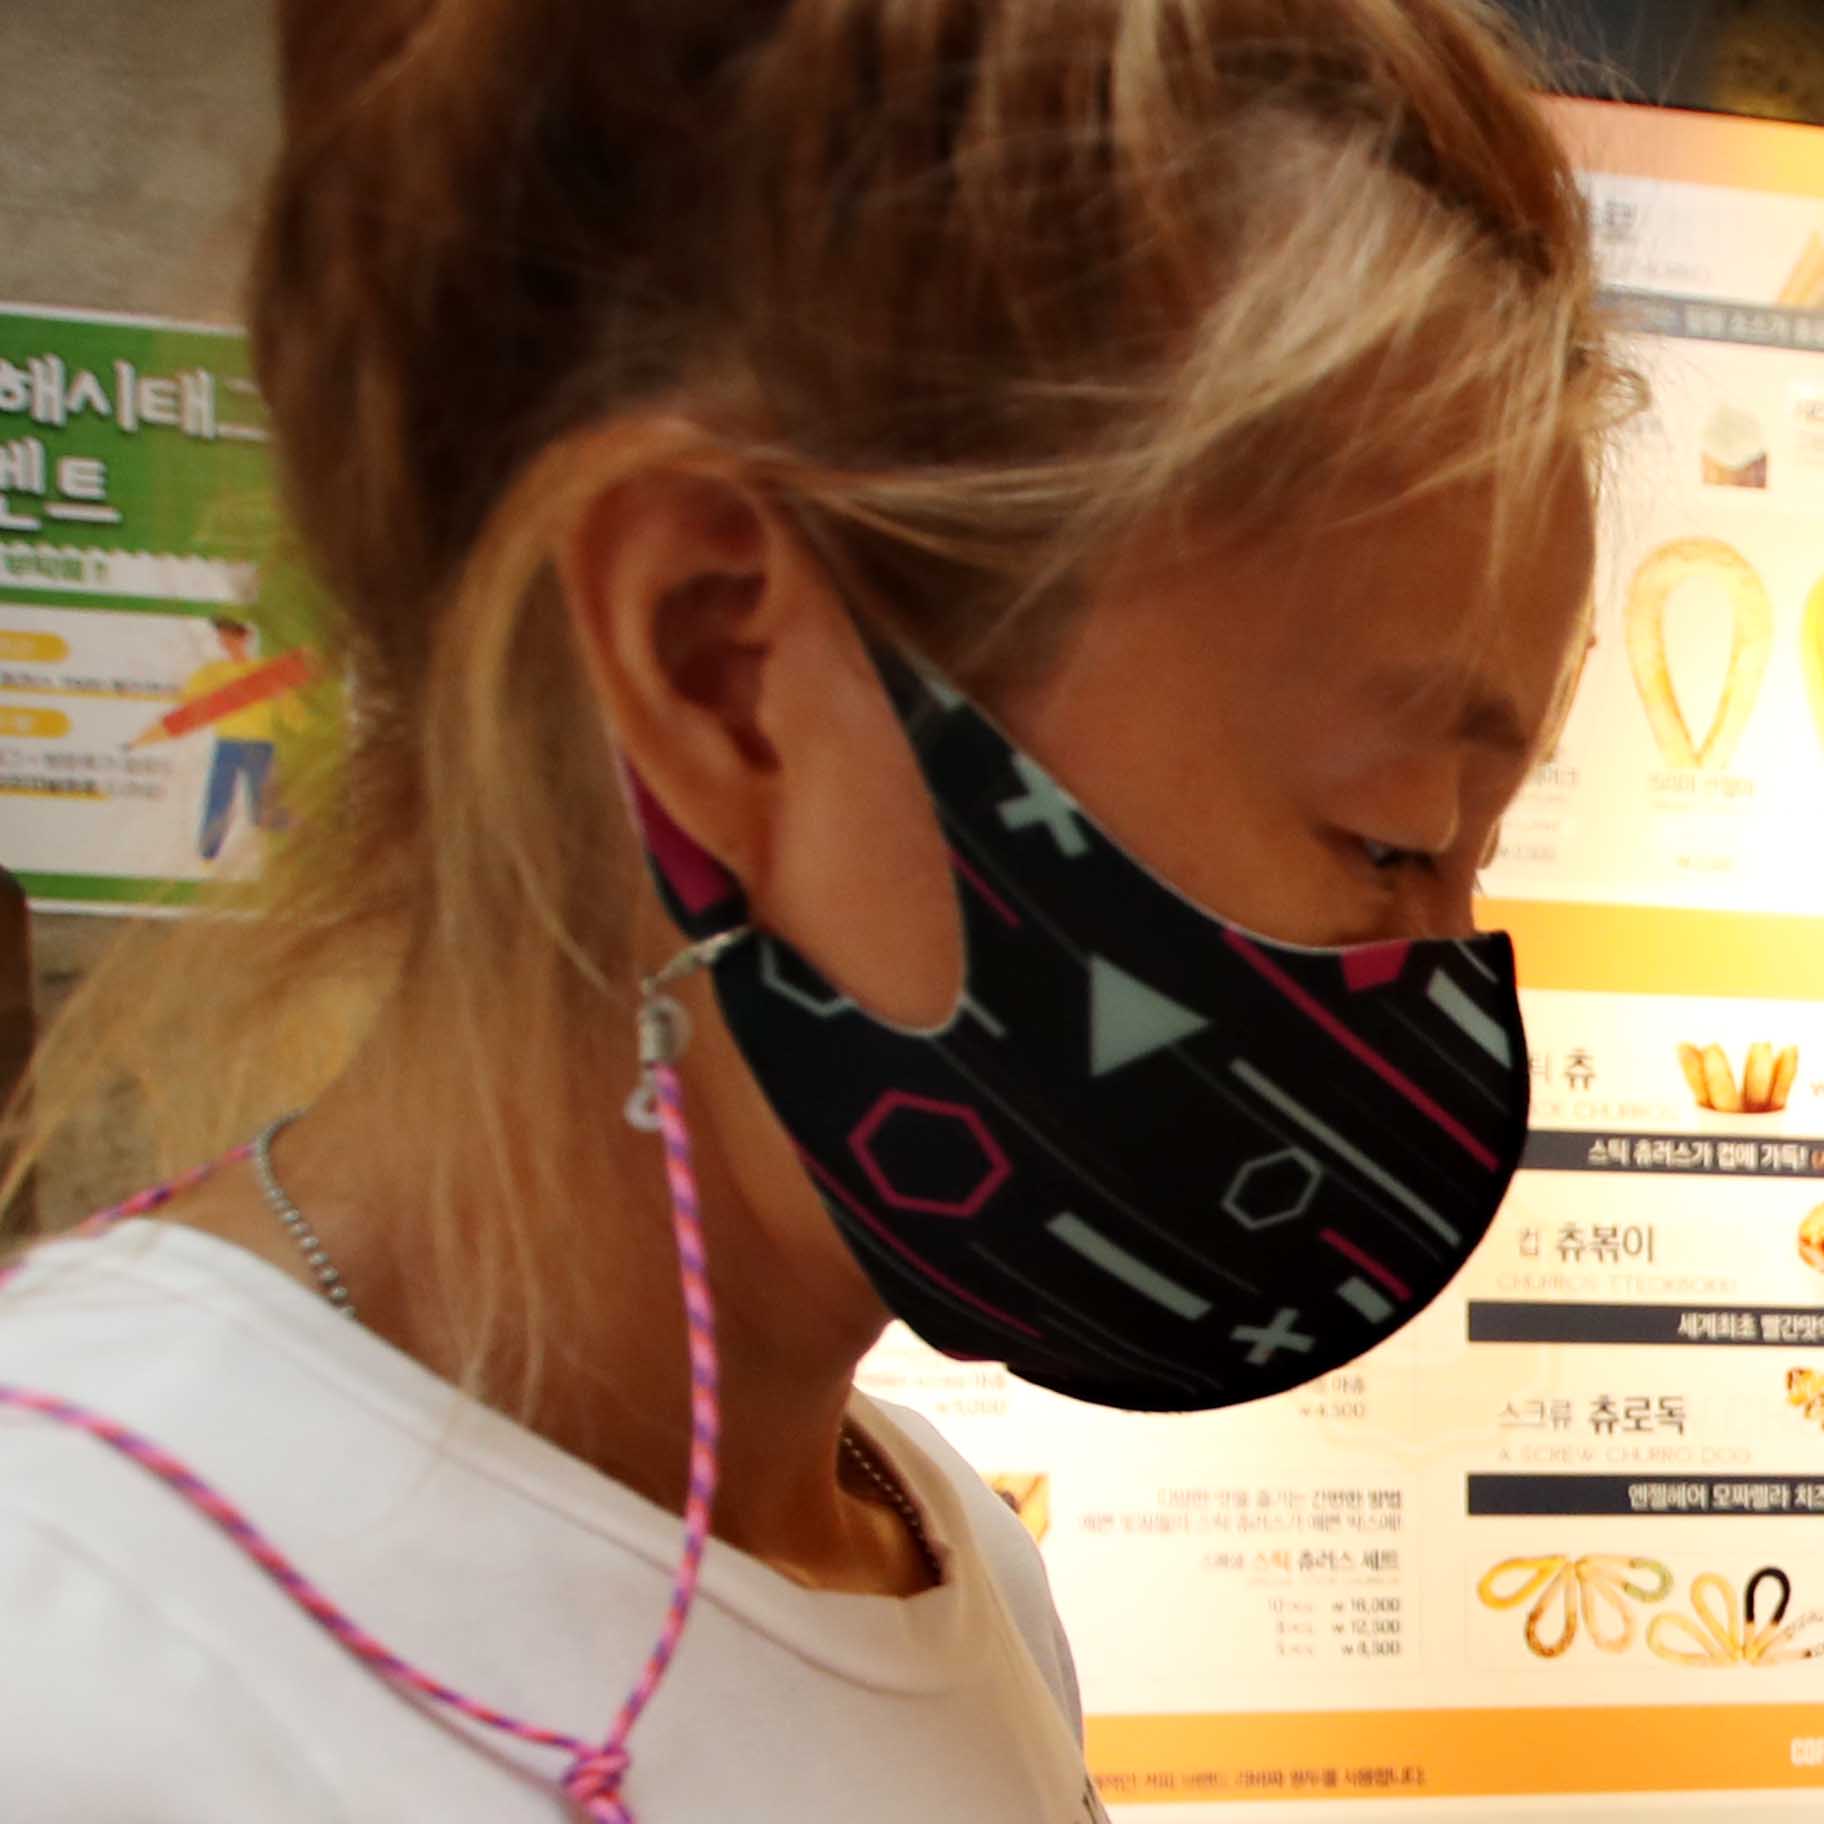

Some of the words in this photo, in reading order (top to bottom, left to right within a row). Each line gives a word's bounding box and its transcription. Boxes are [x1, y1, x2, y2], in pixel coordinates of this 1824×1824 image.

[1587, 1141, 1630, 1166] 스틱
[1633, 1142, 1714, 1168] 츄러스가
[1717, 1143, 1756, 1170] 컵에
[1555, 1223, 1655, 1264] 츄볶이
[1678, 1314, 1757, 1341] 세계최초
[1587, 1396, 1686, 1435] 츄로독
